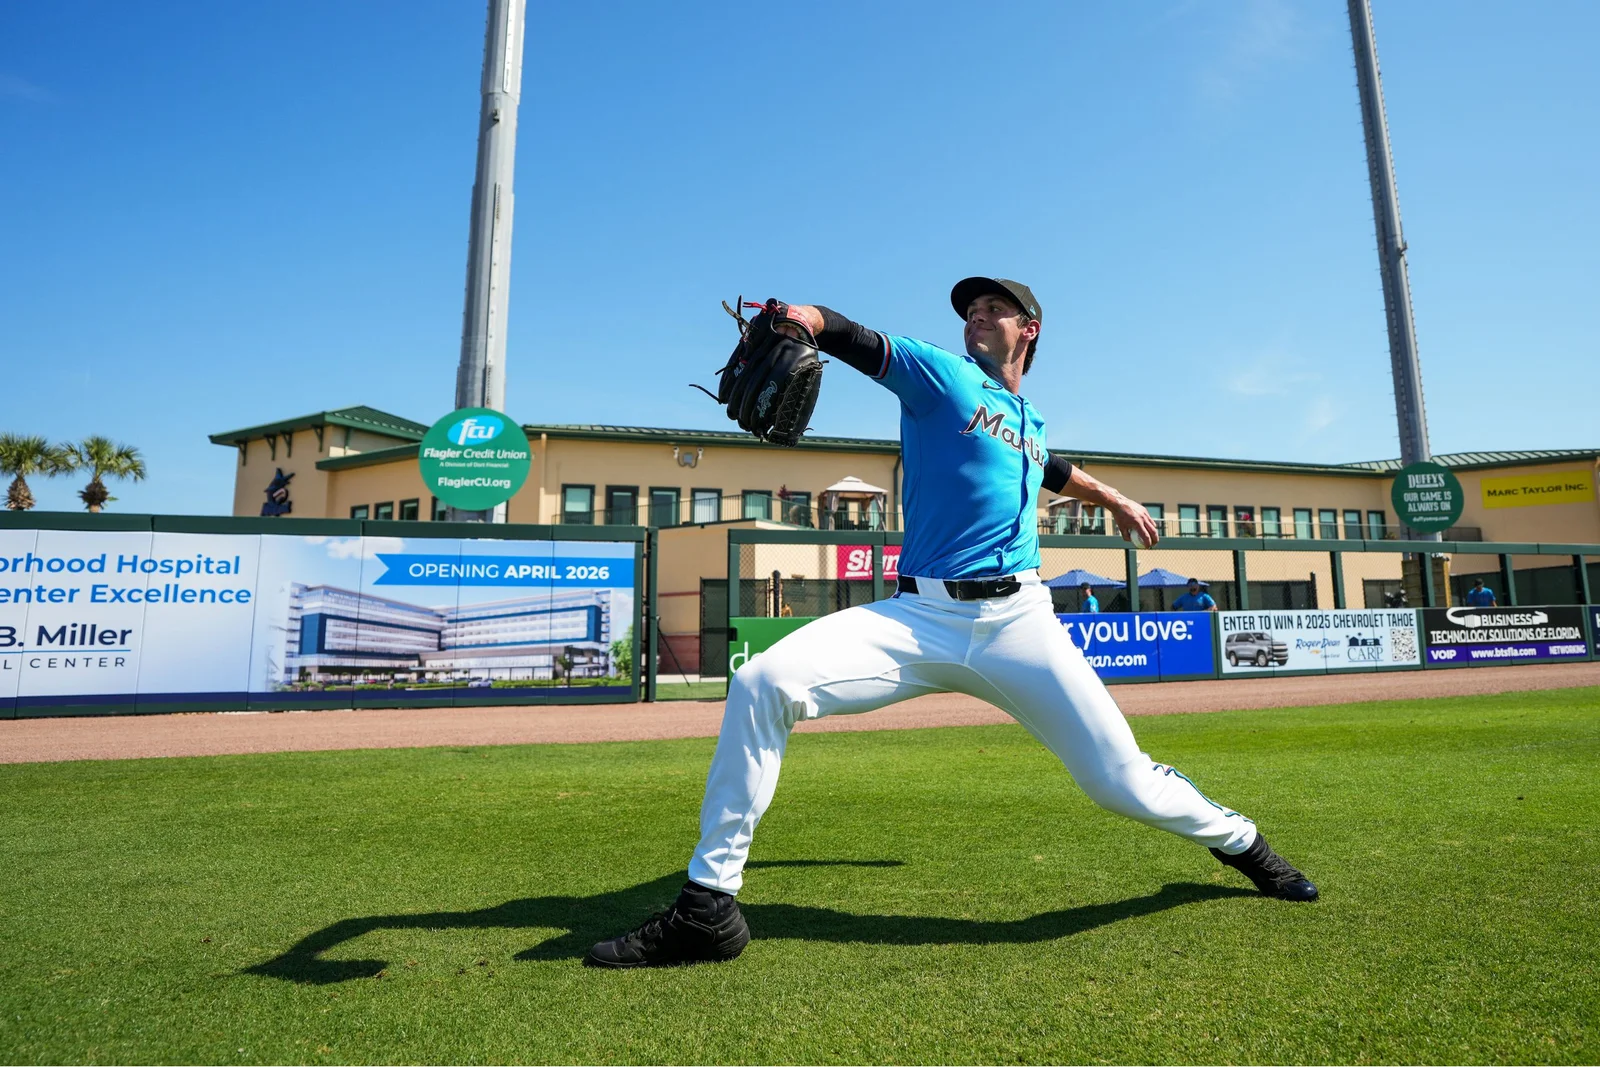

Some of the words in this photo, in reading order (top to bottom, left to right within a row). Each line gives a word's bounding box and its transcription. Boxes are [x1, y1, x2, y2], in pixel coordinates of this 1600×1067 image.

[423, 448, 462, 460] Flagler
[463, 448, 495, 459] Credit
[496, 449, 527, 460] Union
[437, 477, 512, 489] FlaglerCU.org
[1403, 492, 1419, 502] OUR
[1420, 491, 1443, 502] GAME
[1443, 491, 1452, 500] IS
[1408, 502, 1439, 512] ALWAYS
[1440, 501, 1451, 511] ON
[116, 554, 241, 579] Hospital
[408, 563, 500, 579] OPENING
[503, 564, 562, 580] APRIL
[565, 565, 610, 581] 2026
[90, 583, 252, 604] Excellence
[1223, 615, 1256, 631] ENTER
[1259, 615, 1272, 630] TO
[1273, 615, 1294, 630] WIN
[1296, 615, 1303, 629] A
[1305, 614, 1331, 629] 2025
[1333, 613, 1384, 628] CHEVROLET
[1386, 612, 1415, 628] TAHOE
[1481, 614, 1533, 627] BUSINESS
[0, 626, 25, 648] B.
[36, 623, 133, 647] Miller
[1078, 621, 1129, 651] you
[1430, 629, 1488, 644] TECHNOLOGY
[1489, 628, 1535, 642] SOLUTIONS
[1535, 628, 1547, 640] OF
[1547, 627, 1582, 640] FLORIDA
[1296, 638, 1321, 650] Roger
[1321, 637, 1341, 649] Dean
[1347, 646, 1383, 661] CARP
[1431, 649, 1457, 660] VOIP
[1549, 644, 1586, 655] NETWORKING
[29, 656, 126, 670] CENTER
